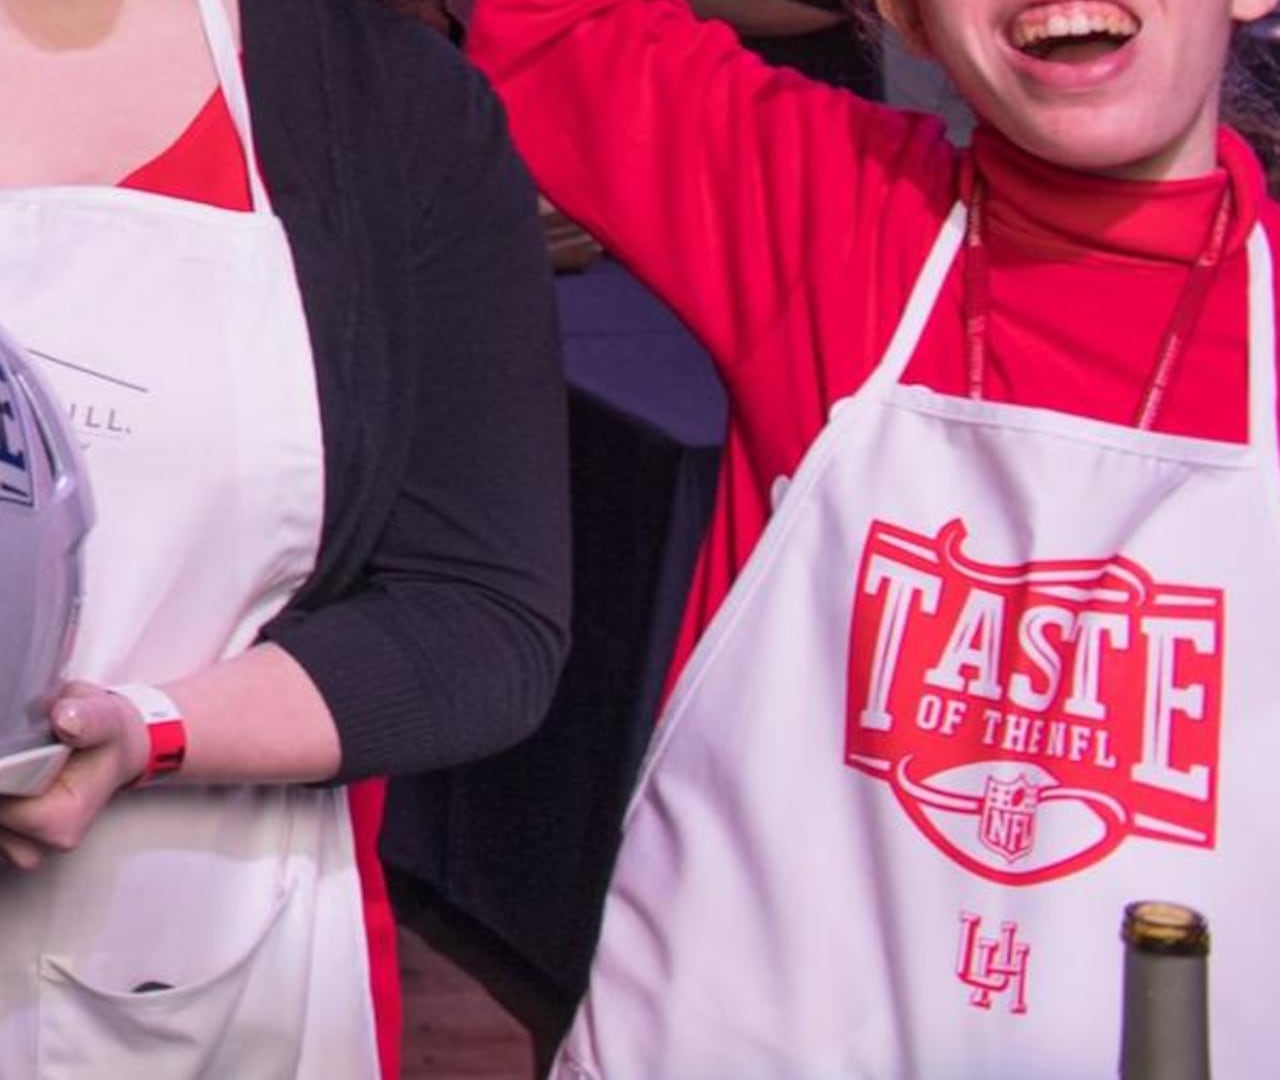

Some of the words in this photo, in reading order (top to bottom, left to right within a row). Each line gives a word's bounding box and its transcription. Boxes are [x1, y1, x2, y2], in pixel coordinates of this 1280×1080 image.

[860, 553, 1216, 801] TASTE
[916, 695, 967, 735] OF
[987, 809, 1031, 852] NFL
